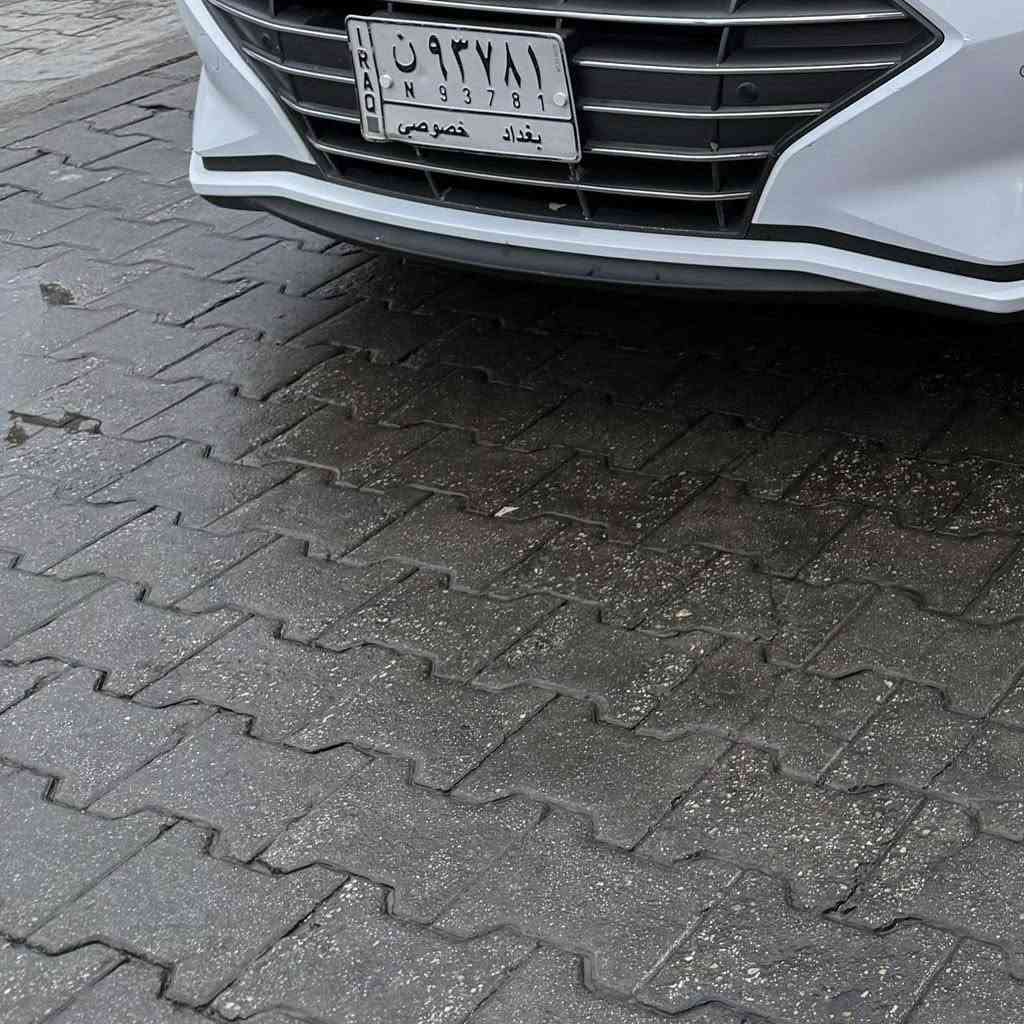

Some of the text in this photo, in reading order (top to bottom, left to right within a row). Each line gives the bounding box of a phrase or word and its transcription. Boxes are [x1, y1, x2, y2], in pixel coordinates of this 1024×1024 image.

[356, 27, 376, 113] IRAQ
[392, 33, 417, 74] ن
[428, 34, 543, 90] ٩٣٧٨١
[404, 81, 546, 112] N 93781
[398, 120, 542, 151] بغداد خصوصي
